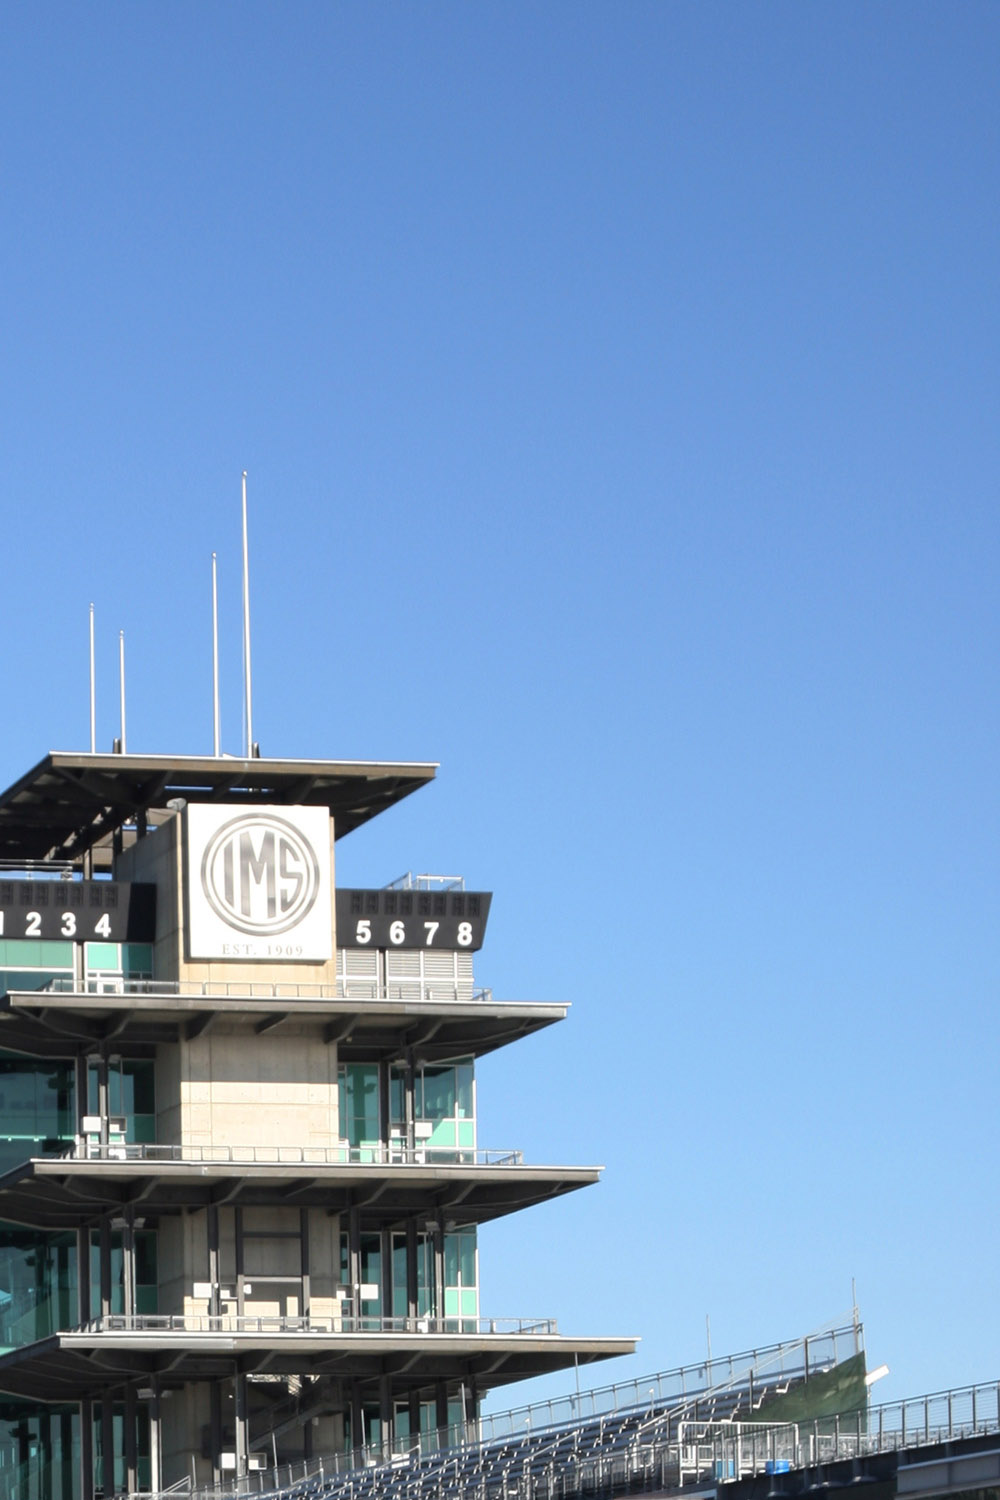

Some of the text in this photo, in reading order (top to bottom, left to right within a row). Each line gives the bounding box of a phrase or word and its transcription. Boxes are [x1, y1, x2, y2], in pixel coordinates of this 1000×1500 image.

[223, 830, 303, 919] IMS
[25, 912, 42, 936] 2
[60, 912, 77, 937] 3
[94, 913, 112, 938] 4
[355, 920, 473, 946] 5 6 7 8
[222, 944, 303, 956] EST. 1909
